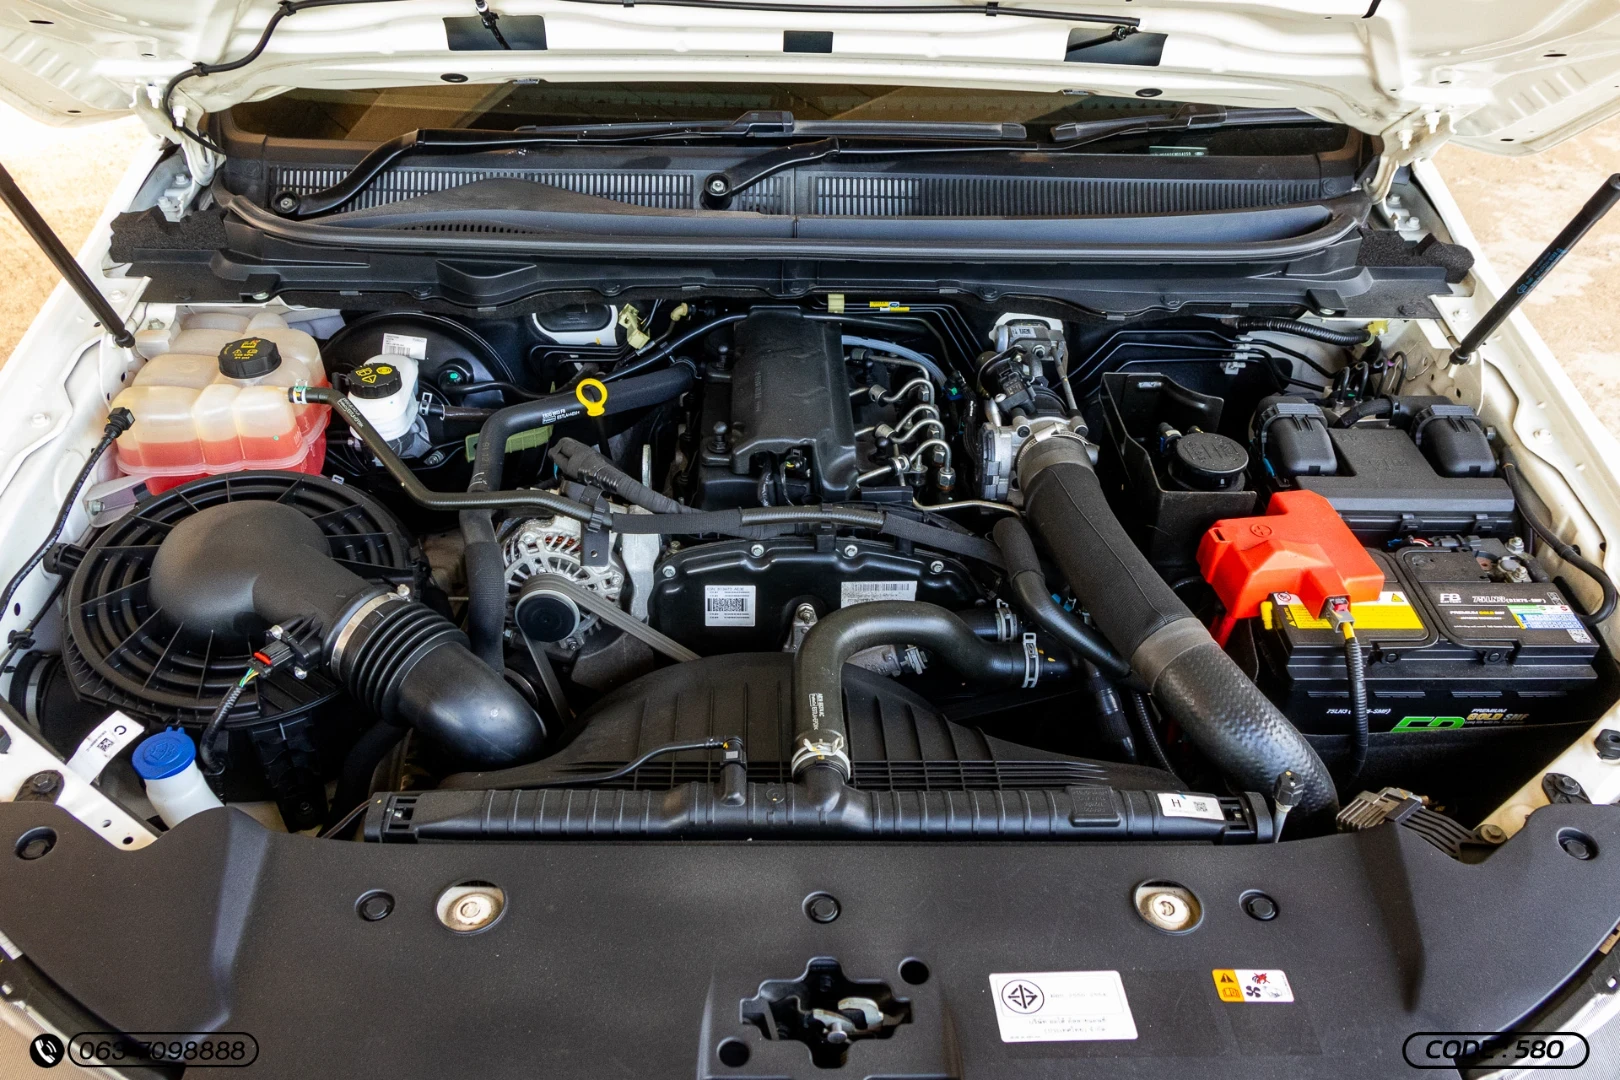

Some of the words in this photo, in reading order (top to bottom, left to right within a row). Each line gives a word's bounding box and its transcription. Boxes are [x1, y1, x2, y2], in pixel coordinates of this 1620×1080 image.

[1466, 713, 1503, 721] GOLD
[114, 725, 127, 736] C
[1171, 799, 1181, 808] H
